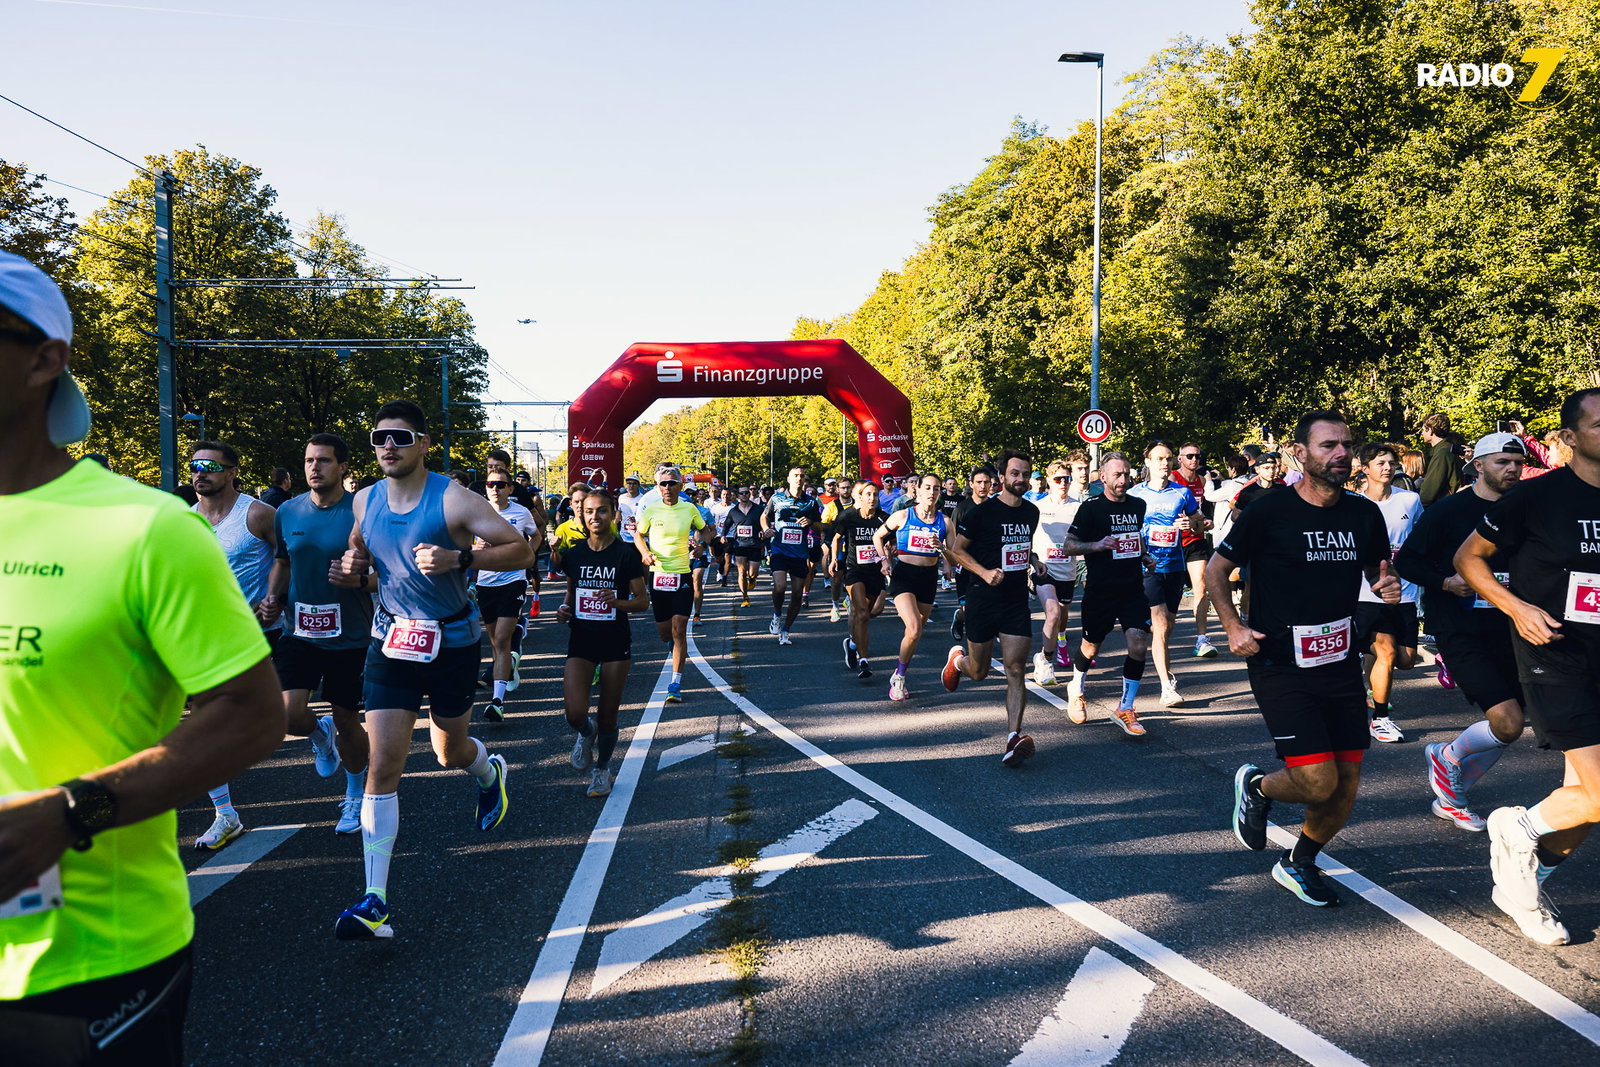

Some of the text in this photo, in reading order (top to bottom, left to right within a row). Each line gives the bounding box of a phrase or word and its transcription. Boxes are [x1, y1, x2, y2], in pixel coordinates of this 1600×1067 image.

[694, 366, 823, 385] Finanzgruppe
[1085, 419, 1104, 433] 60
[878, 434, 908, 442] Sparkasse
[582, 441, 614, 449] Sparkasse
[1110, 514, 1138, 524] TEAM
[1002, 523, 1030, 535] TEAM
[1577, 519, 1600, 539] TE
[1119, 541, 1138, 550] 5627
[1303, 531, 1356, 549] TEAM
[1009, 552, 1028, 562] 4320
[1306, 550, 1357, 562] BANTLEON
[3, 562, 64, 576] Ulrich
[579, 566, 616, 580] TEAM
[578, 580, 615, 588] BANTLEON
[658, 577, 675, 585] 4992
[302, 616, 331, 628] 8259
[393, 631, 428, 647] 2406
[1308, 635, 1343, 652] 4356
